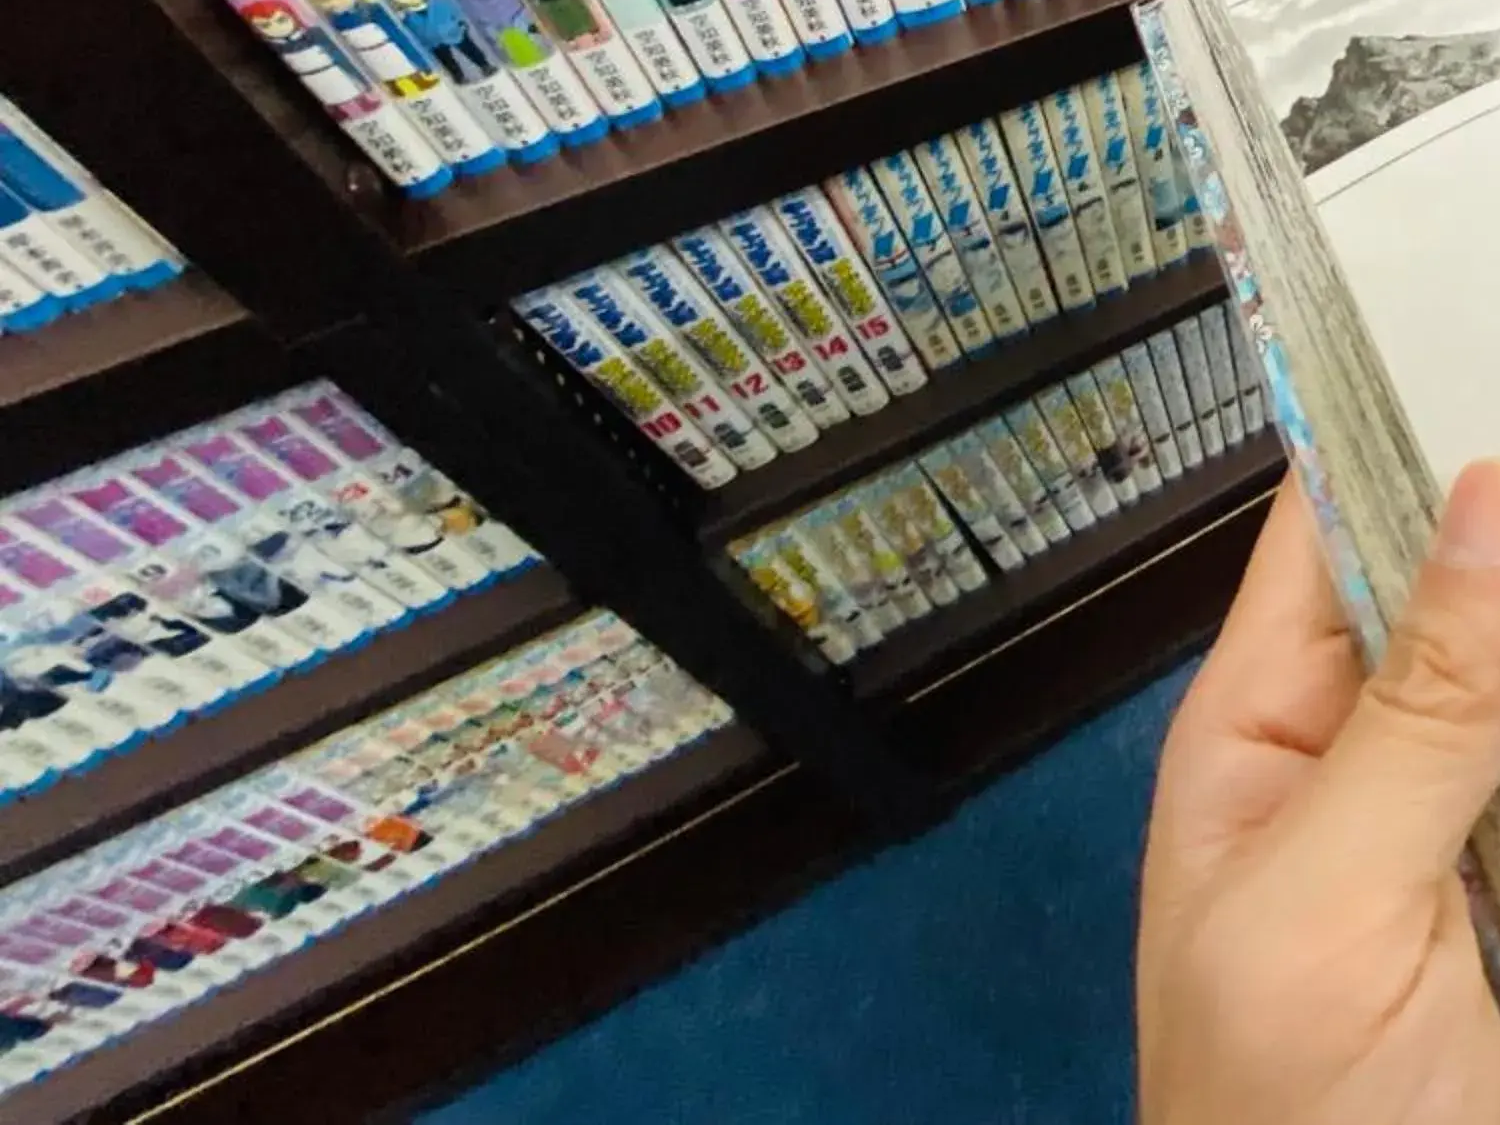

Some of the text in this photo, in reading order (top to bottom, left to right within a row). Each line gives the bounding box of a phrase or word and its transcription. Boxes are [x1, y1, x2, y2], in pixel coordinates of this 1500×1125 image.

[857, 316, 890, 340] 15
[812, 336, 849, 361] 14
[772, 351, 806, 375] 13
[731, 373, 769, 399] 12
[683, 395, 721, 418] 11
[641, 412, 683, 439] 10
